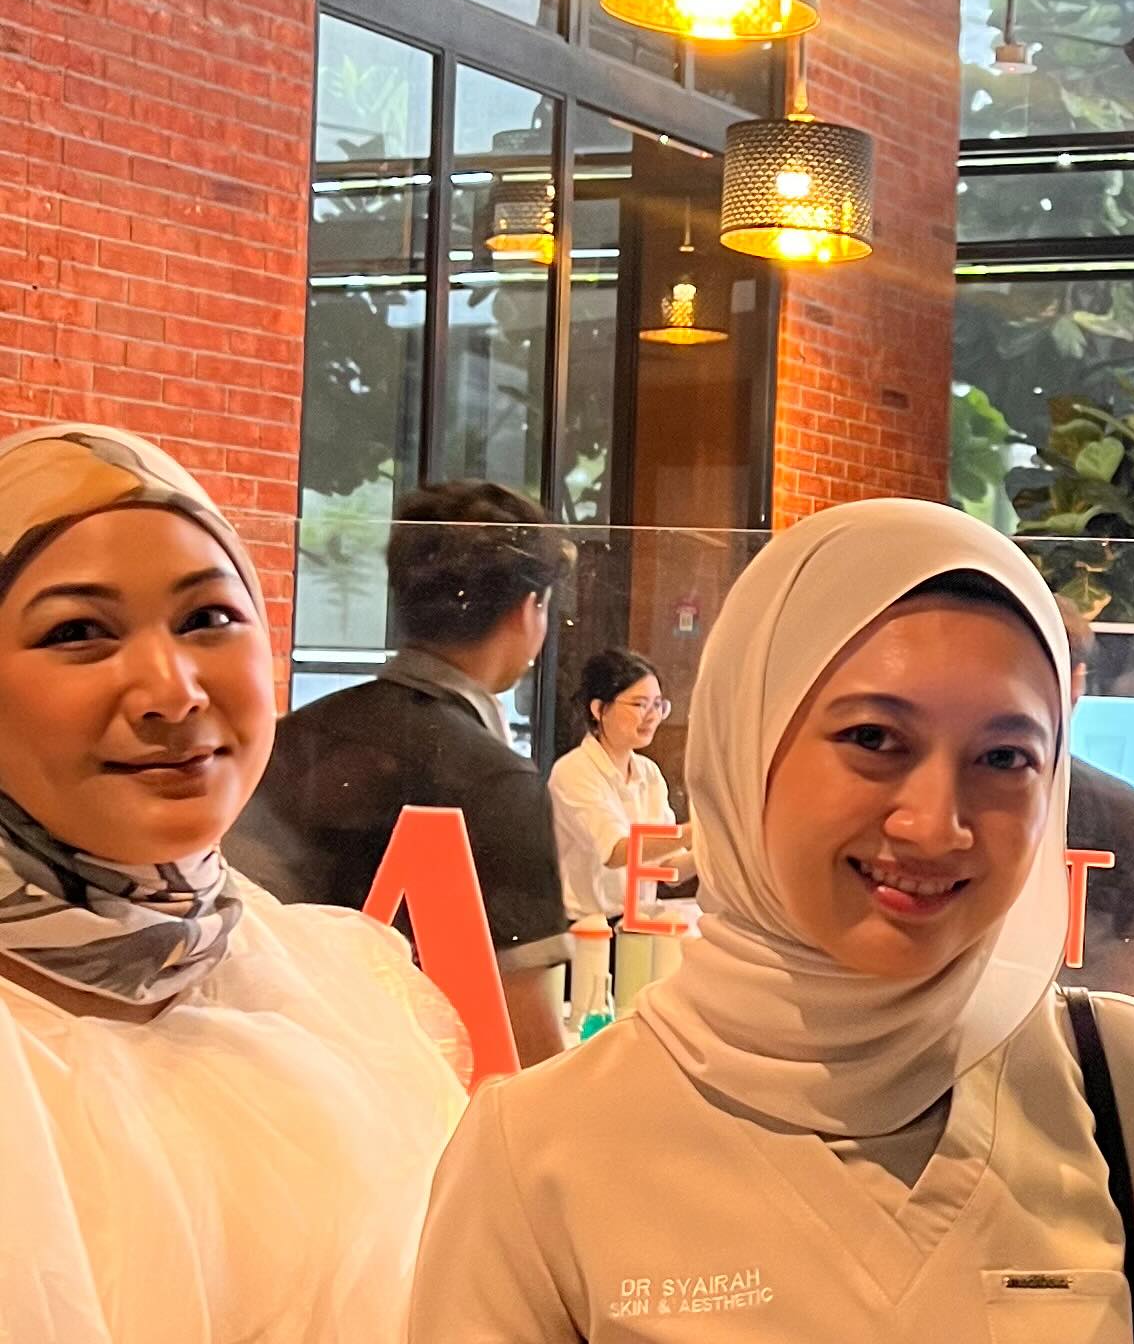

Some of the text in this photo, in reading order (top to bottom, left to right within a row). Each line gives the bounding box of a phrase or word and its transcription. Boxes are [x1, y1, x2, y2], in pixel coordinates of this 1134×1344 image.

[621, 1268, 761, 1297] DR SYAIRAH
[609, 1299, 649, 1318] SKIN
[679, 1287, 774, 1313] AESTHETIC
